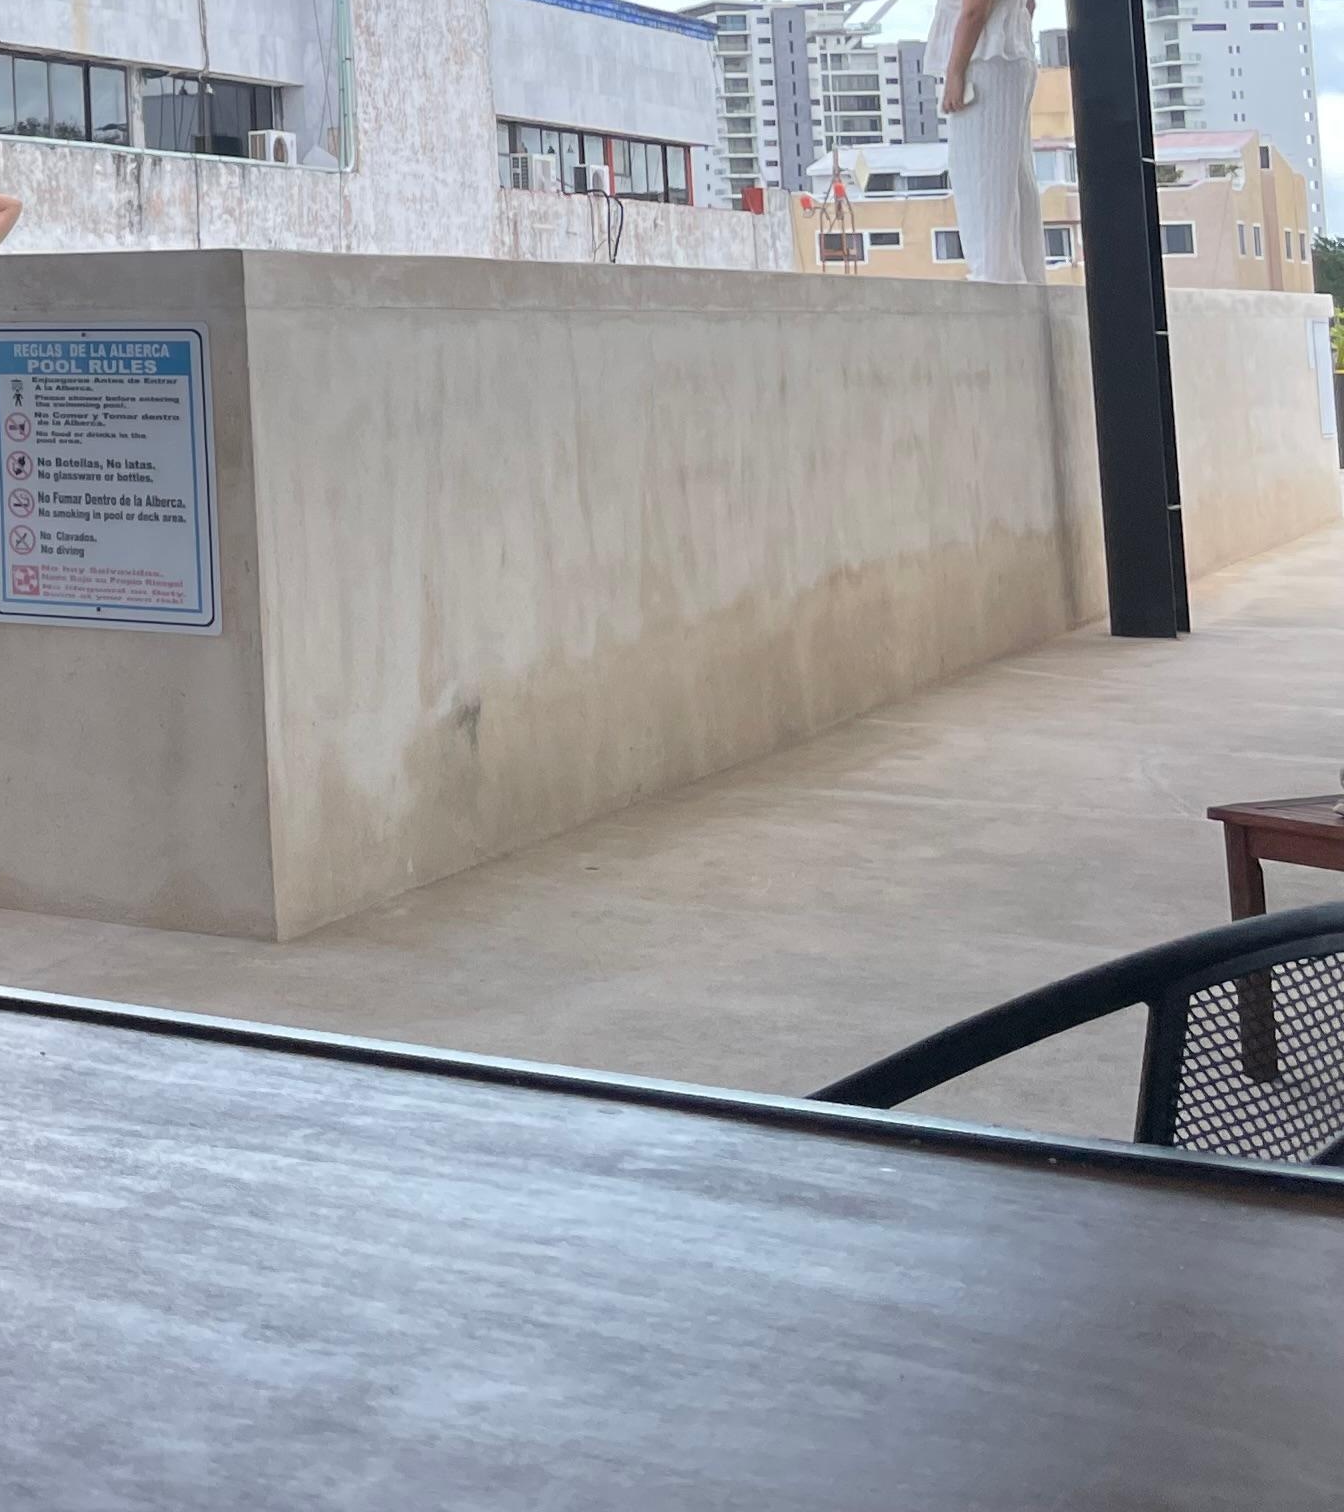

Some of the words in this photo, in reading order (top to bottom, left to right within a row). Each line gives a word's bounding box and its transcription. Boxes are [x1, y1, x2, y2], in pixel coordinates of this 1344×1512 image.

[13, 343, 62, 358] REGLAS
[70, 343, 86, 358] DE
[90, 343, 106, 358] LA
[110, 343, 170, 358] ALBERCA
[27, 359, 82, 373] POOL
[88, 359, 157, 374] RULES
[37, 457, 51, 467] No
[55, 457, 103, 470] Botellas,
[106, 459, 121, 469] No
[125, 459, 156, 470] latas.
[38, 470, 50, 479] No
[54, 471, 101, 482] glassware
[104, 473, 114, 481] or
[117, 472, 153, 483] bottles.
[38, 492, 50, 503] No
[53, 492, 82, 505] Fumar
[85, 493, 117, 506] Dentro
[120, 494, 131, 506] de
[134, 494, 142, 506] la
[145, 495, 186, 508] Alberca.
[38, 508, 50, 517] No
[53, 509, 90, 521] smoking
[93, 510, 101, 520] in
[104, 510, 123, 522] pool
[126, 513, 135, 521] or
[137, 512, 160, 522] deck
[40, 531, 52, 540] No
[56, 531, 97, 542] Clavados.
[41, 544, 53, 554] No
[56, 546, 85, 558] diving
